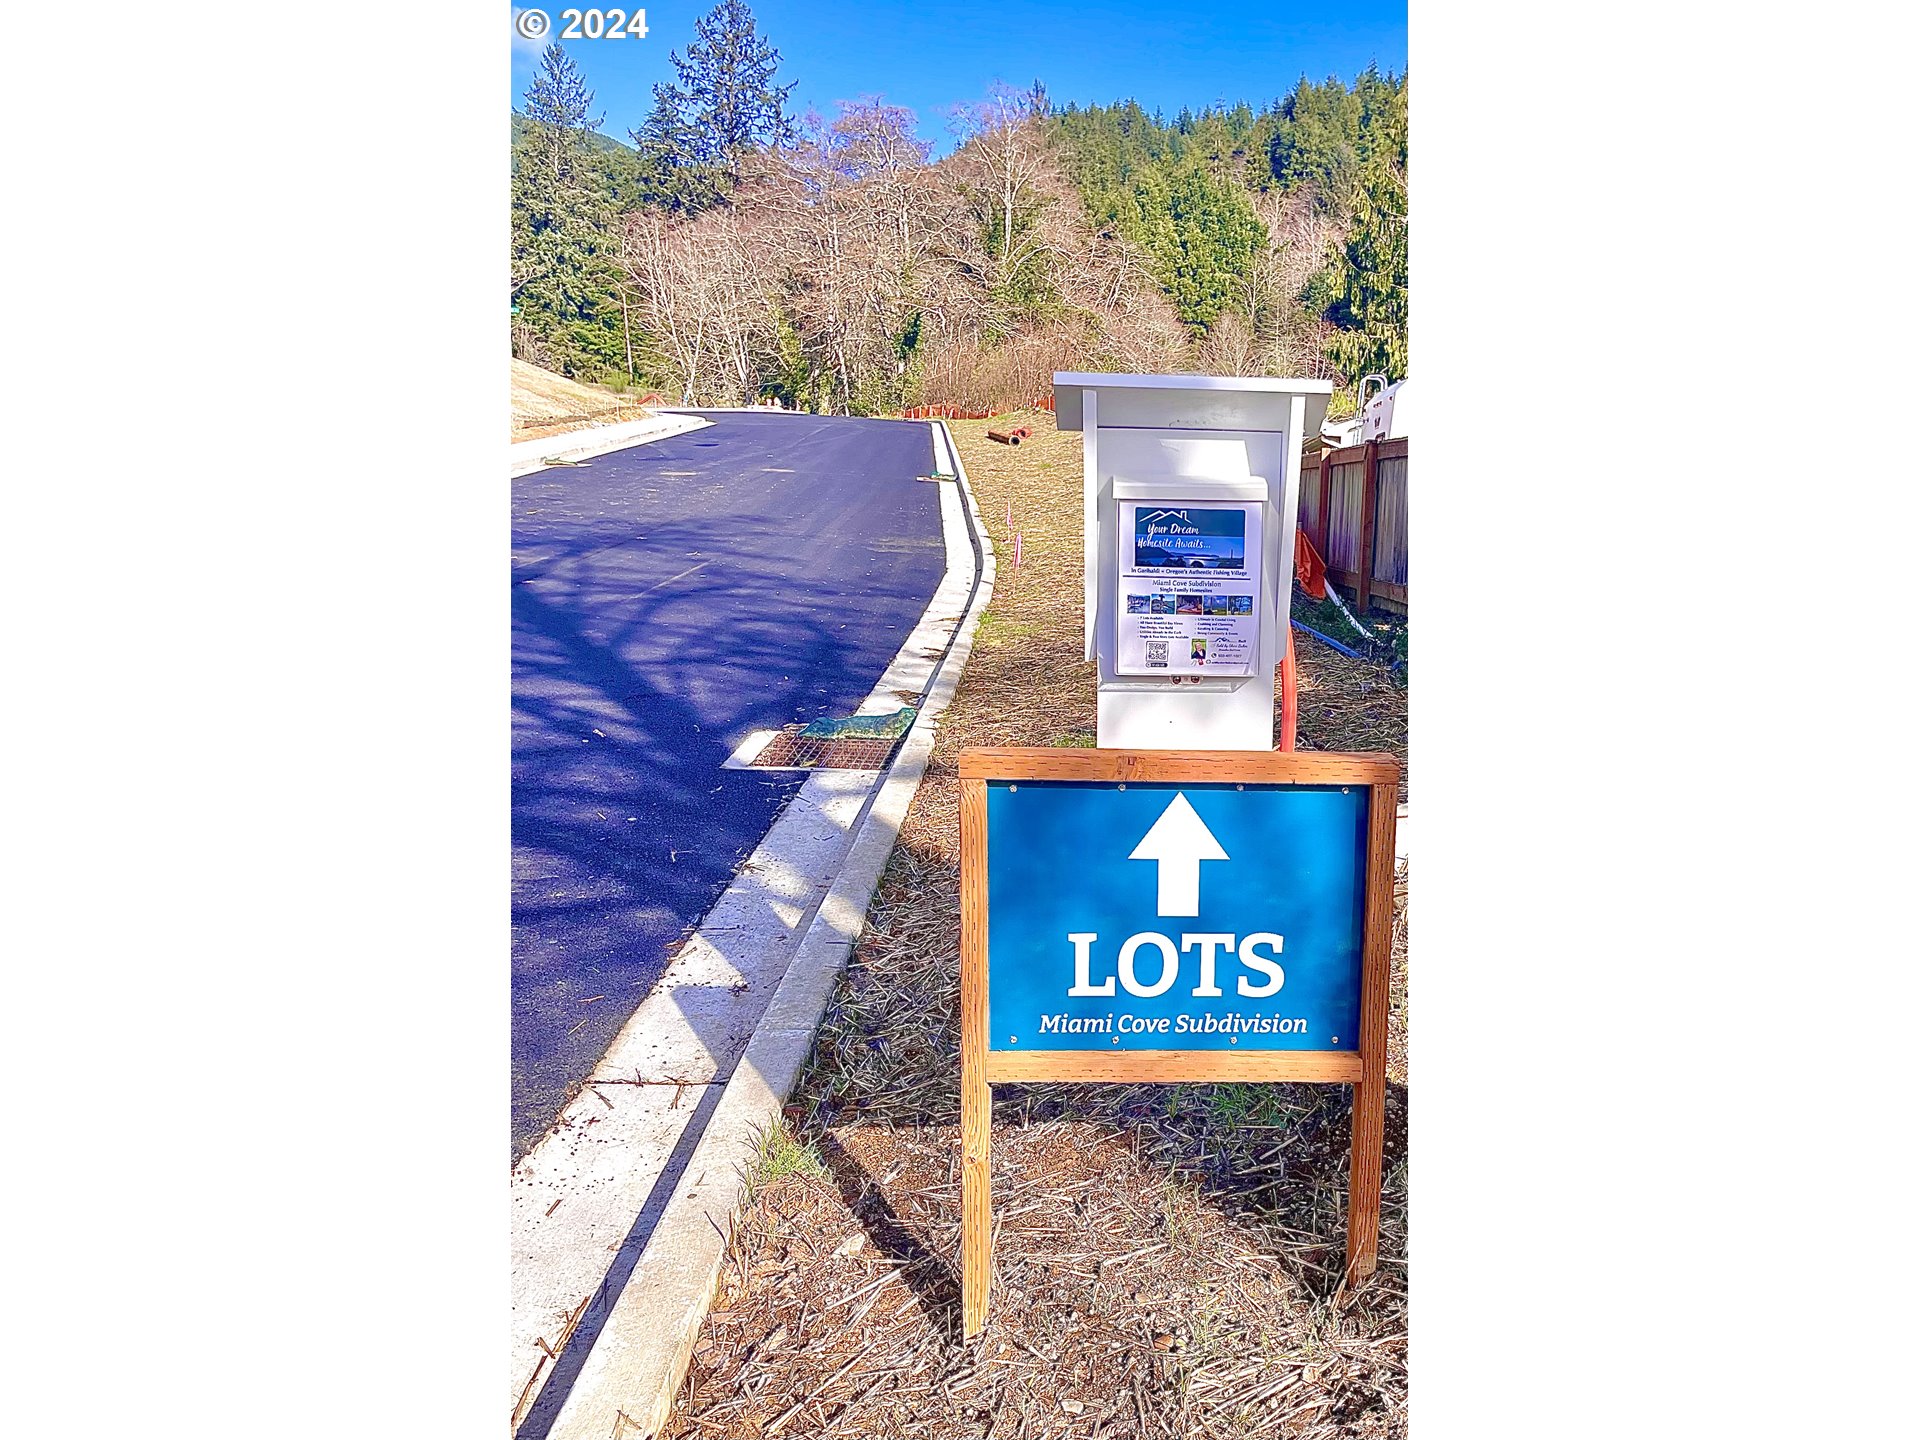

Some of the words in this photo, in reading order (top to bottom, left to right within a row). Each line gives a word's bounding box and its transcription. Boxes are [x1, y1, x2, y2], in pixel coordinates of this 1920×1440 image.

[1148, 523, 1168, 540] Your
[1170, 523, 1200, 534] Dream
[1137, 537, 1173, 548] Homesite
[1067, 931, 1286, 998] LOTS
[1038, 1012, 1114, 1033] Miami
[1117, 1014, 1171, 1033] Cove
[1174, 1012, 1308, 1033] Subdivision
